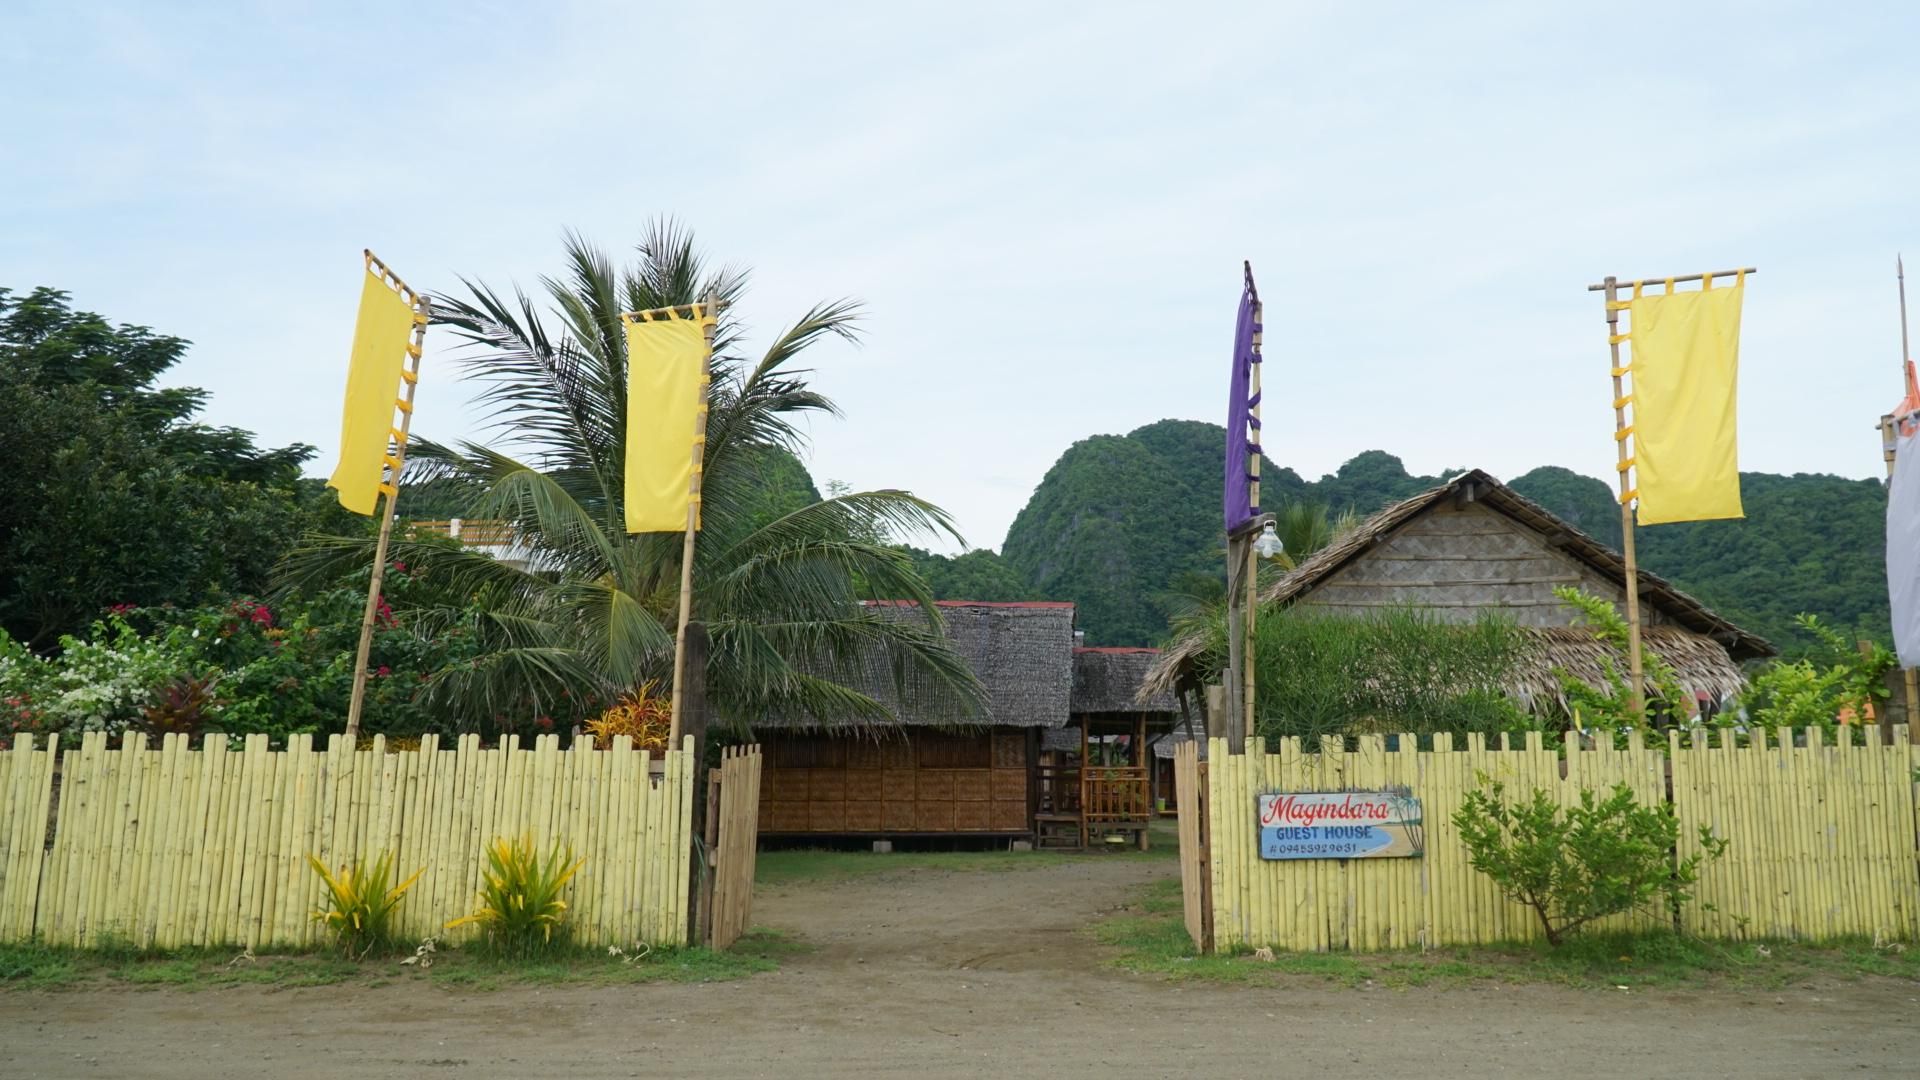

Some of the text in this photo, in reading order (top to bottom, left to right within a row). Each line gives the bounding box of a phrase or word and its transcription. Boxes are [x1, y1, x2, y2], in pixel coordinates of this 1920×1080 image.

[1263, 795, 1389, 826] Magindara
[1276, 826, 1373, 840] GUEST HOUSE
